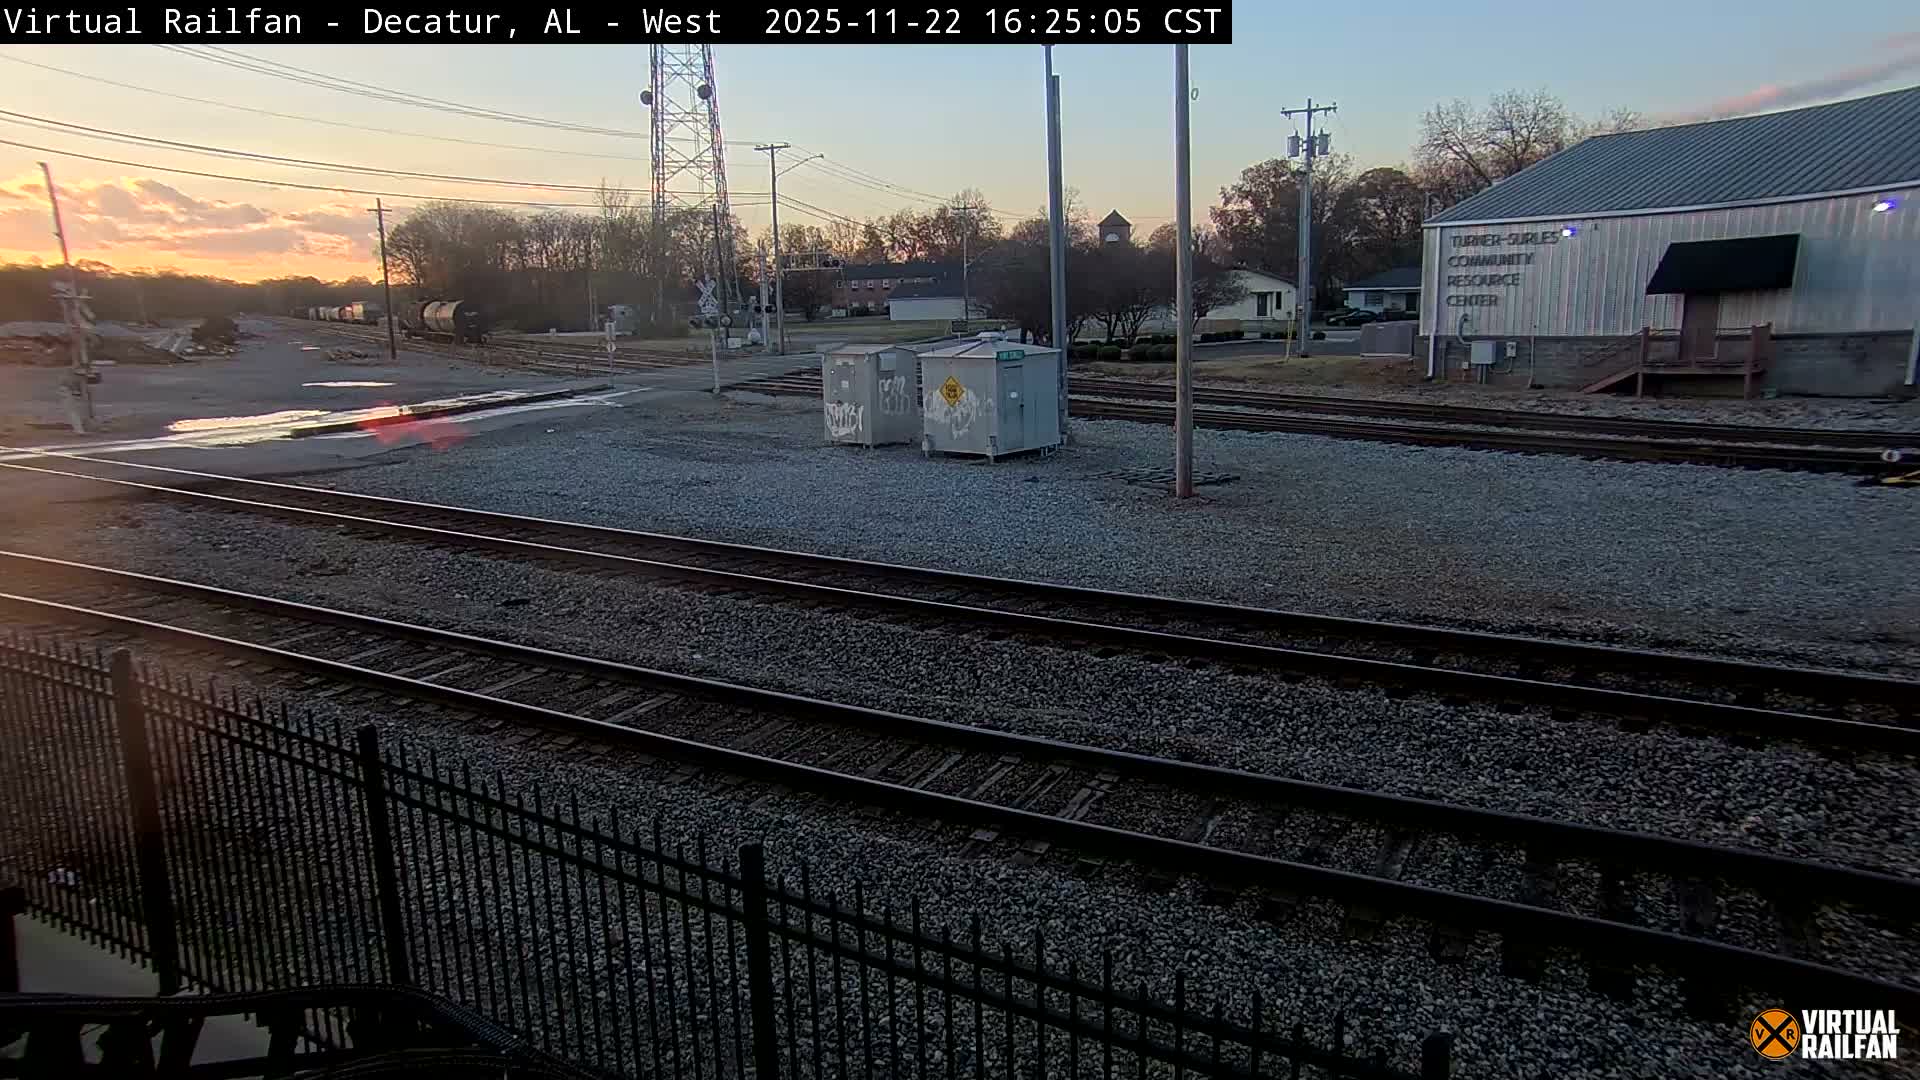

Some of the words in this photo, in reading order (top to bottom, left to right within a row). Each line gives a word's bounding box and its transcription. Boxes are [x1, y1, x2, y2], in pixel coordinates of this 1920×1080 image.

[1450, 231, 1559, 248] TURNER-SURLES
[1447, 252, 1535, 267] COMMUNITY
[1447, 272, 1520, 287] RESOURCE
[1446, 294, 1498, 307] CENTER
